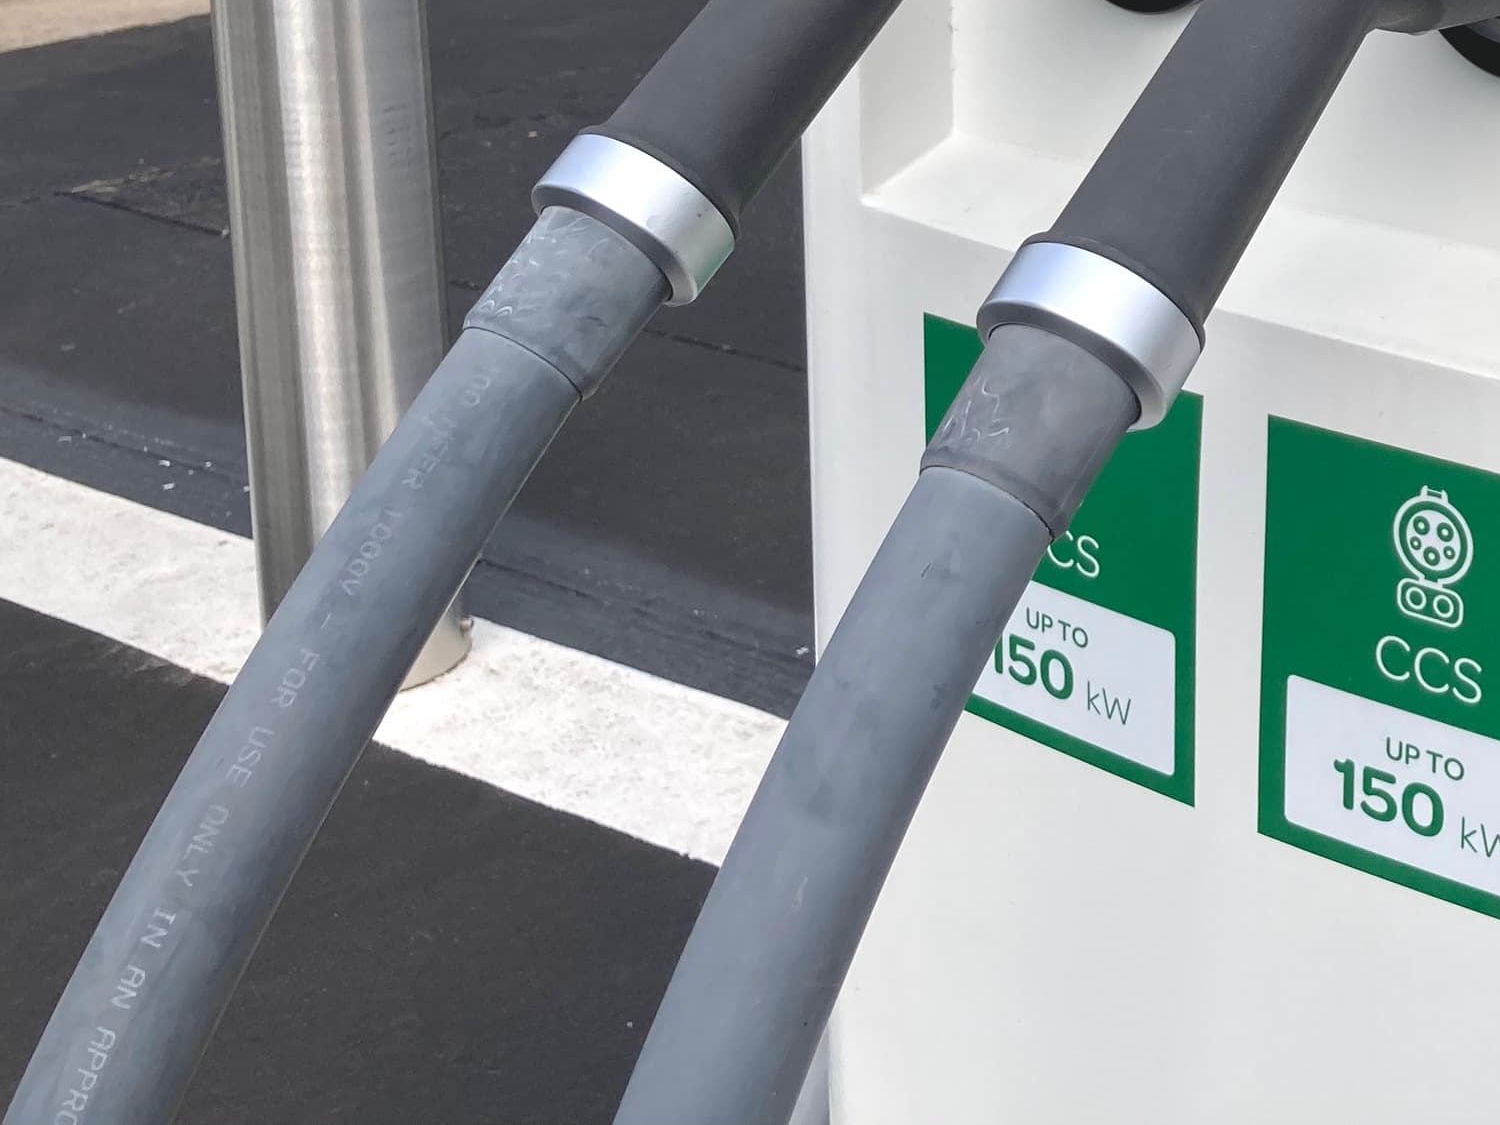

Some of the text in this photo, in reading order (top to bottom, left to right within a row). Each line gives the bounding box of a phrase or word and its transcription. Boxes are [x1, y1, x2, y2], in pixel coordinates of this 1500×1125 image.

[1047, 530, 1101, 578] CS
[1026, 607, 1089, 648] UP TO
[271, 646, 320, 710] FOR
[1375, 635, 1483, 705] CCS
[1086, 680, 1132, 726] kW
[226, 726, 275, 786] USE
[1385, 736, 1465, 783] UP TO
[1333, 757, 1444, 837] 150
[178, 805, 233, 888] ONLY
[139, 908, 179, 960] IN
[113, 961, 150, 1011] AN
